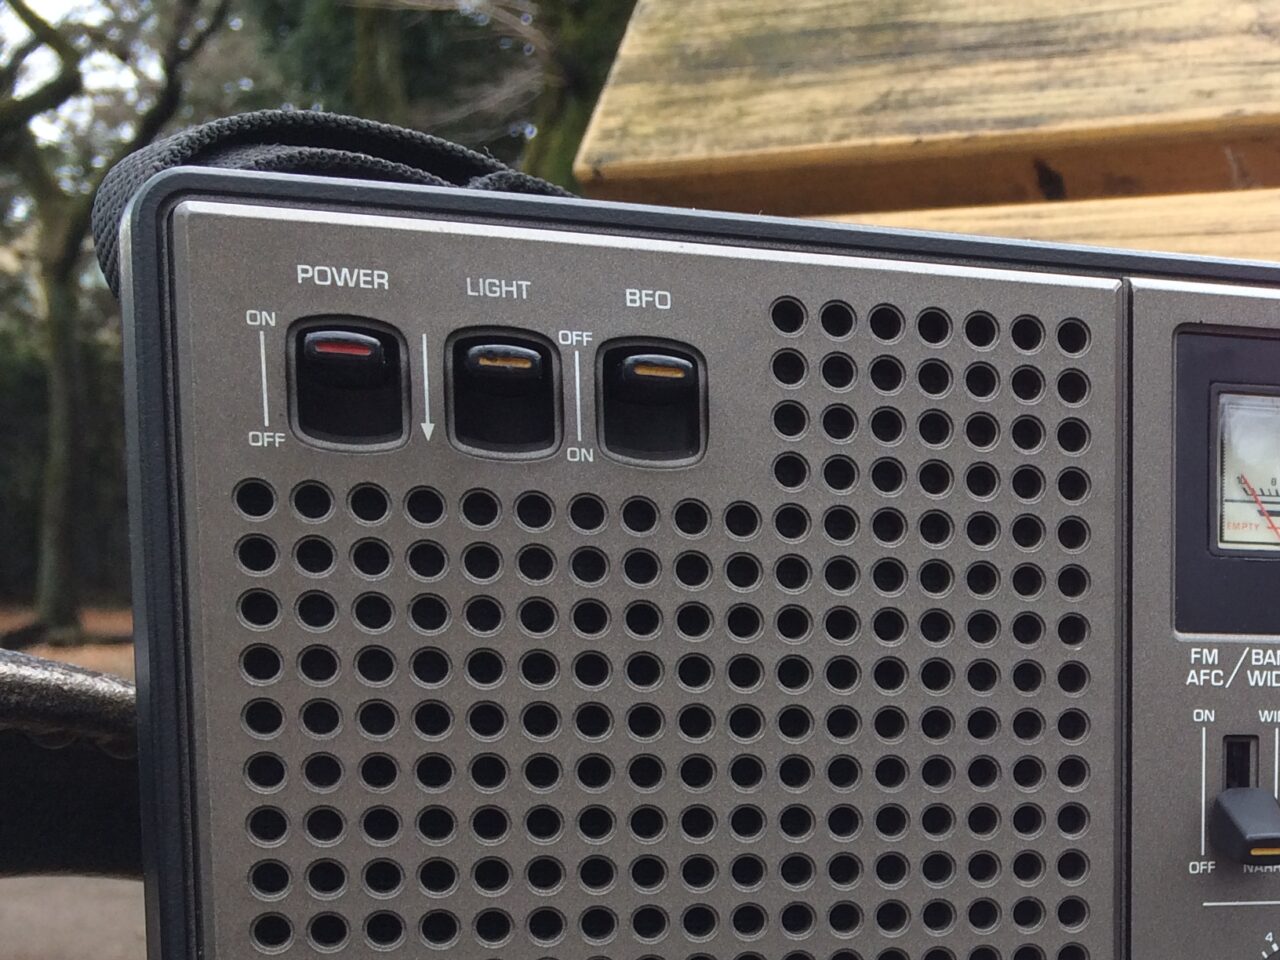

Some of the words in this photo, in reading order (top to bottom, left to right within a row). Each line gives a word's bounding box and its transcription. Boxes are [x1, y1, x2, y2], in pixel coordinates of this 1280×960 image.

[297, 264, 389, 290] POWER
[466, 277, 532, 300] LIGHT
[625, 288, 672, 310] BFO
[245, 310, 276, 327] ON
[559, 330, 593, 346] OFF
[248, 432, 286, 448] OFF
[566, 446, 594, 463] ON
[1226, 522, 1260, 530] EMPTY
[1190, 648, 1219, 665] FM
[1186, 670, 1224, 686] AFC
[1193, 710, 1215, 722] ON
[1188, 862, 1216, 874] OFF
[1265, 932, 1274, 942] 4
